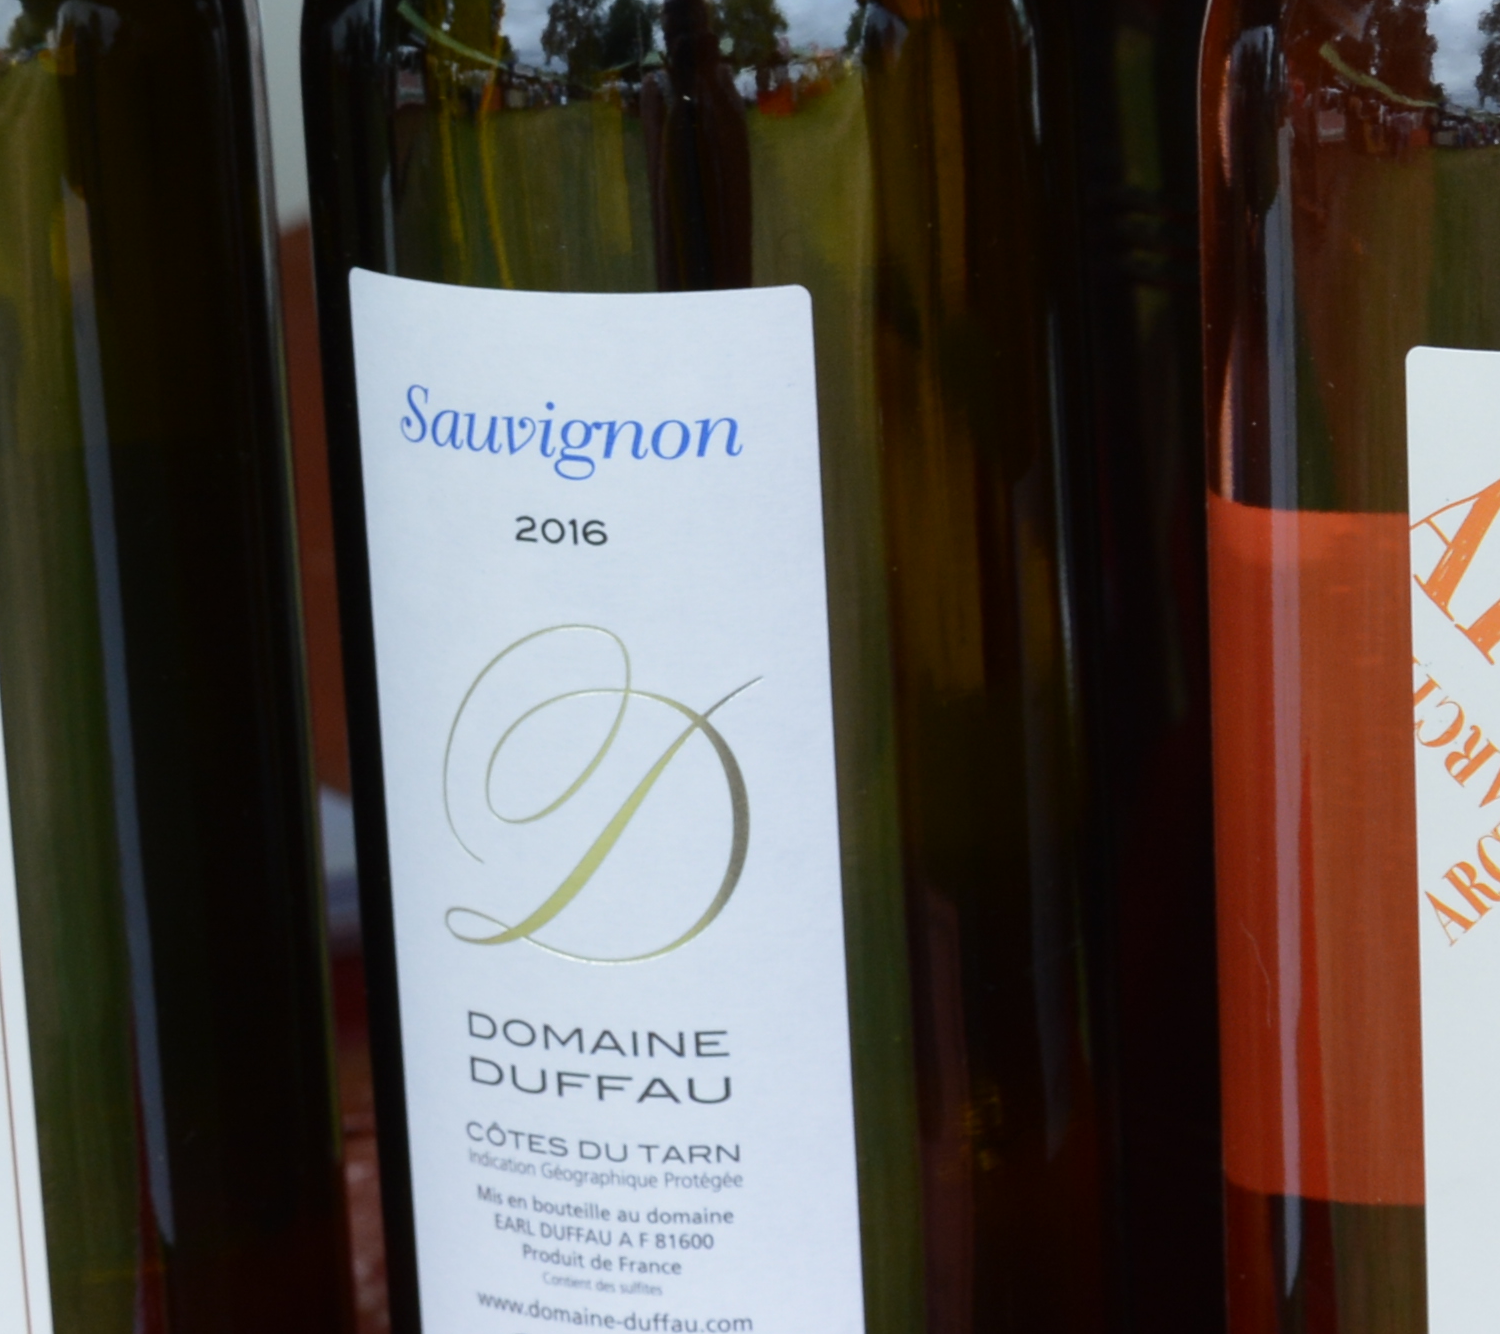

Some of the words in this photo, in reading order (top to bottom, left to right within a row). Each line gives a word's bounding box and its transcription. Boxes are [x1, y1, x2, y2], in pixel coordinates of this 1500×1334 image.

[399, 384, 744, 480] Sauvignon
[515, 515, 609, 547] 2016
[467, 1010, 731, 1058] DOMAINE
[470, 1055, 732, 1104] DUFFAU
[466, 1120, 569, 1157] CÔTES
[578, 1140, 628, 1163] DU
[637, 1144, 741, 1165] TARN
[541, 1161, 658, 1191] Géographique
[664, 1172, 744, 1193] Protégée
[476, 1184, 505, 1206] Mis
[508, 1193, 528, 1210] en
[532, 1195, 610, 1222] bouteille
[617, 1210, 640, 1224] au
[646, 1207, 735, 1225] domaine
[494, 1213, 536, 1237] EARL
[540, 1221, 612, 1247] DUFFAU
[618, 1232, 634, 1248] A
[640, 1232, 649, 1248] F
[655, 1233, 715, 1250] 81600
[522, 1243, 585, 1269] Produit
[590, 1254, 613, 1272] de
[619, 1256, 683, 1276] France
[477, 1291, 754, 1334] www.domaine-duffau.com
